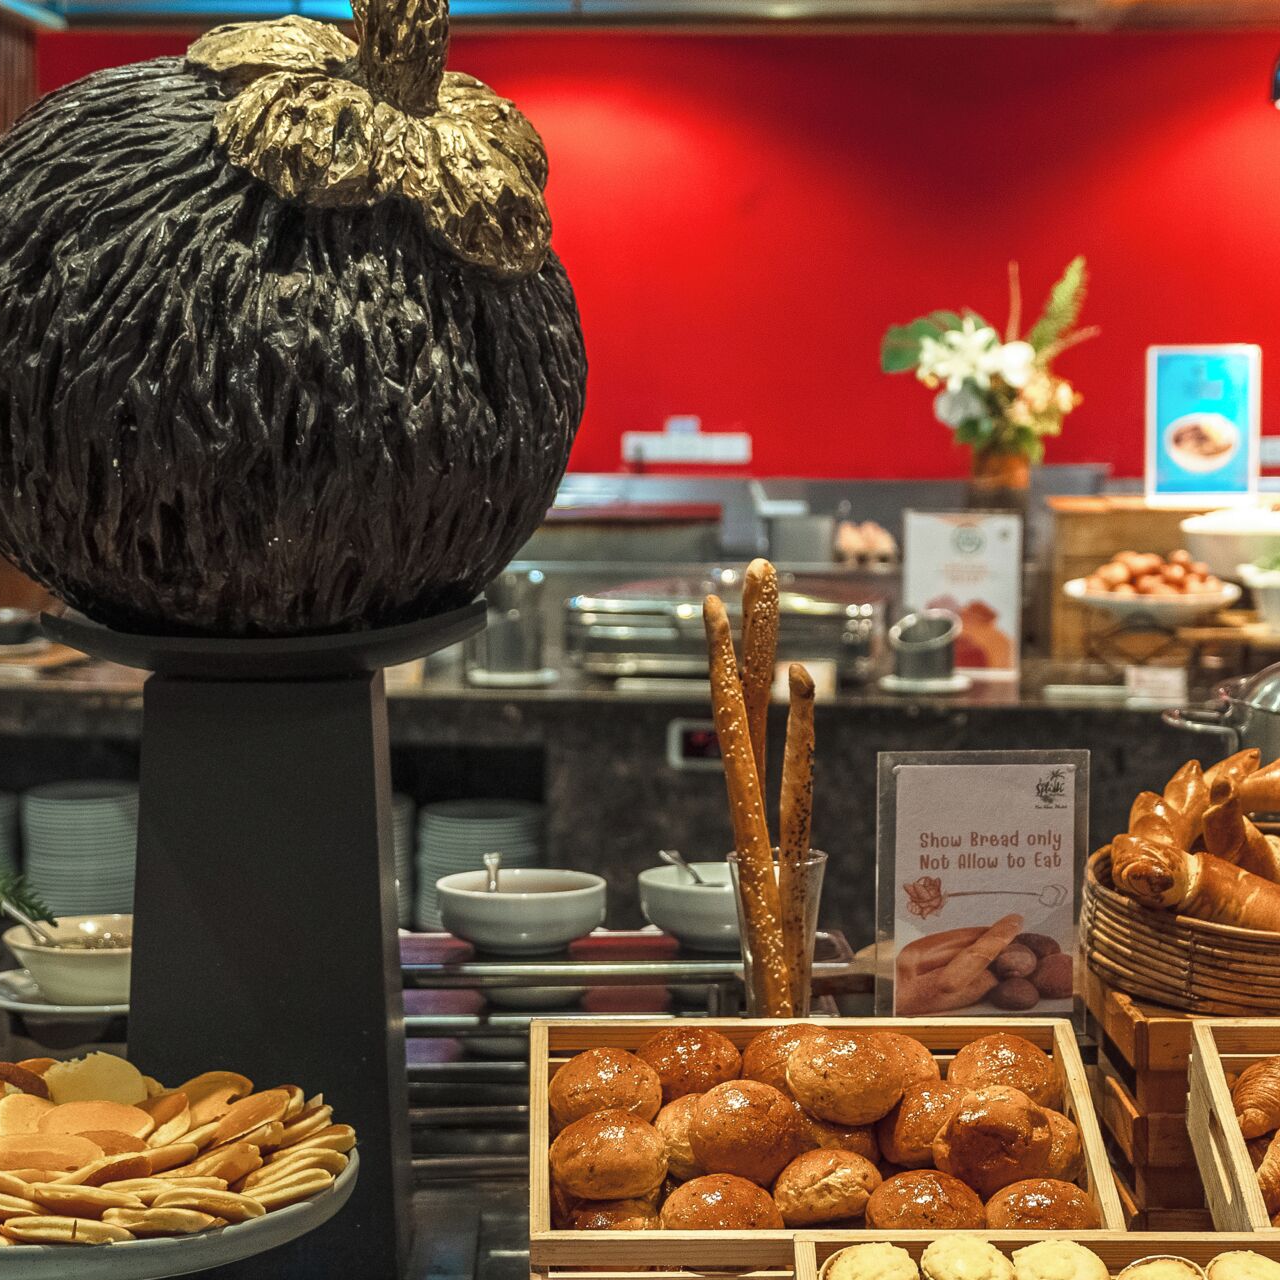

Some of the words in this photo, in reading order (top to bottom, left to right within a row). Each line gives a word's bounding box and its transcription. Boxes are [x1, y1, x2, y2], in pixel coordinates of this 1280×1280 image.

[919, 832, 962, 848] Show
[970, 830, 1019, 848] Bread
[1027, 830, 1062, 851] only
[919, 853, 950, 870] Not
[958, 853, 998, 869] Allow
[1007, 853, 1025, 868] to
[1034, 851, 1062, 868] Eat
